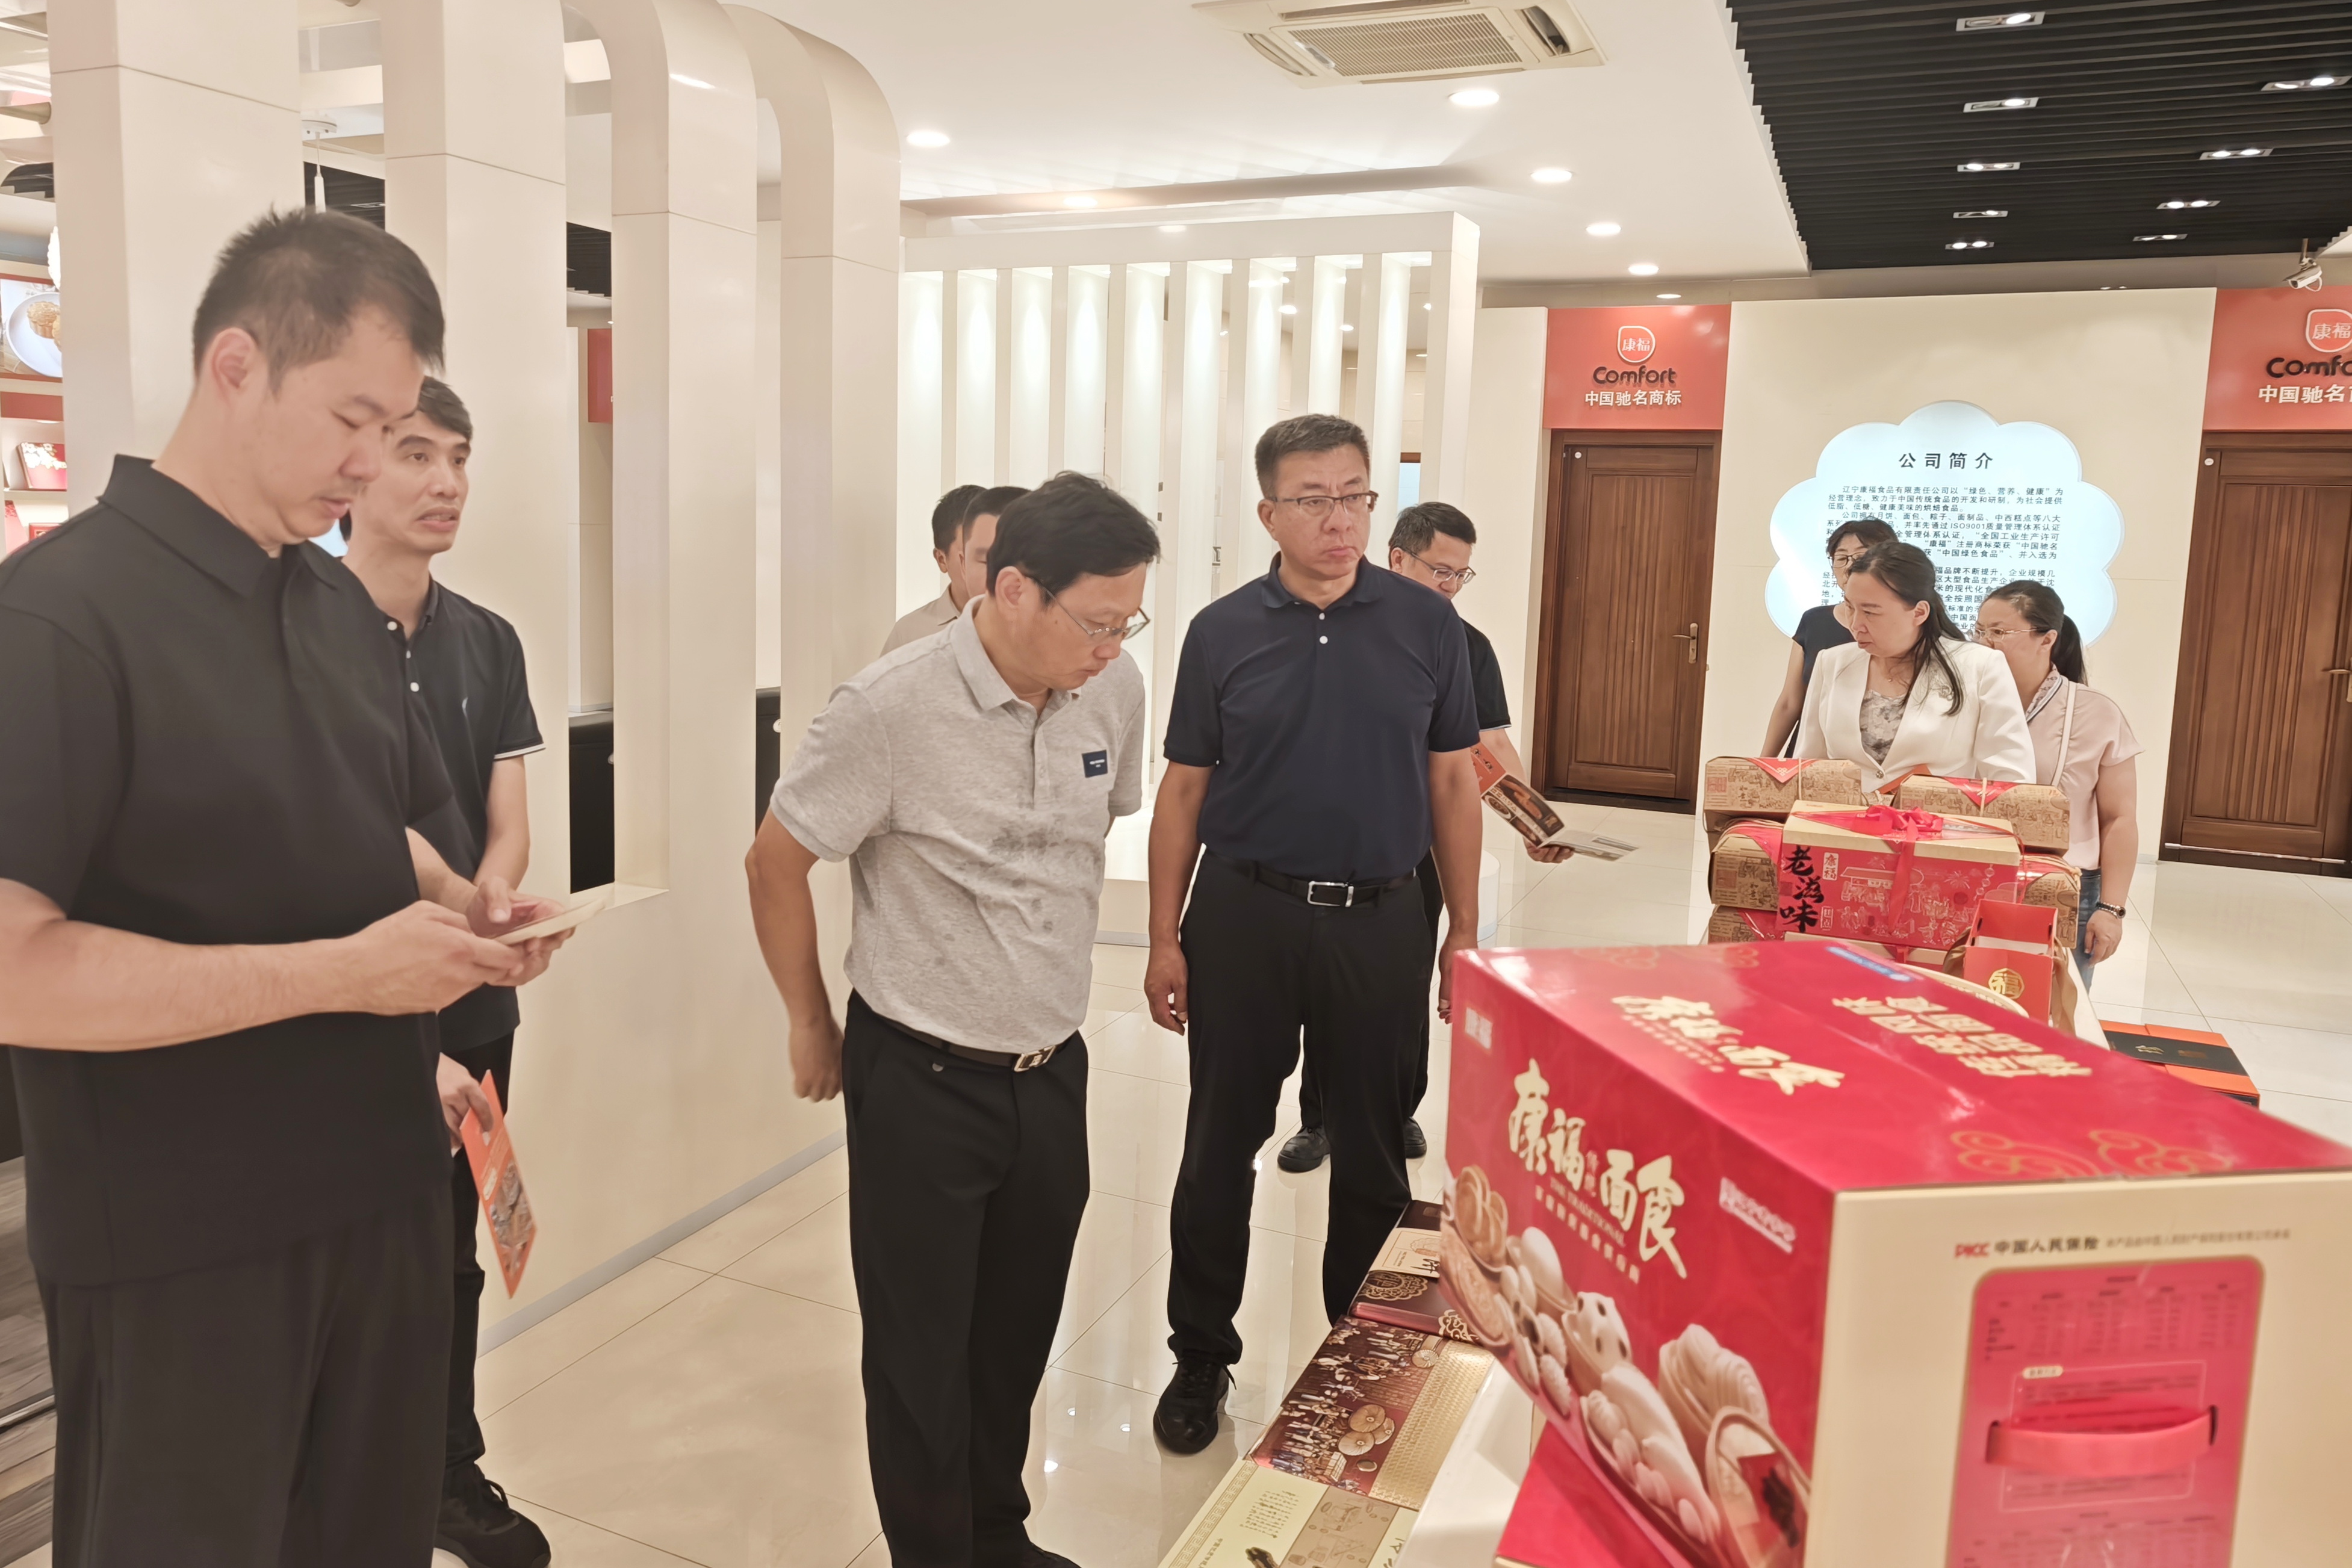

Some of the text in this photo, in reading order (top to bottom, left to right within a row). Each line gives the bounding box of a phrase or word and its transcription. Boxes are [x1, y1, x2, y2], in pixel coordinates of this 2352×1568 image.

[2312, 322, 2352, 340] 康福
[1622, 337, 1651, 352] 康福
[1593, 365, 1677, 385] Comfort
[1584, 389, 1682, 407] 中国驰名商标
[2258, 384, 2352, 404] 中国驰名
[1898, 452, 1993, 469] 公司简介
[1780, 844, 1825, 934] 老滋味
